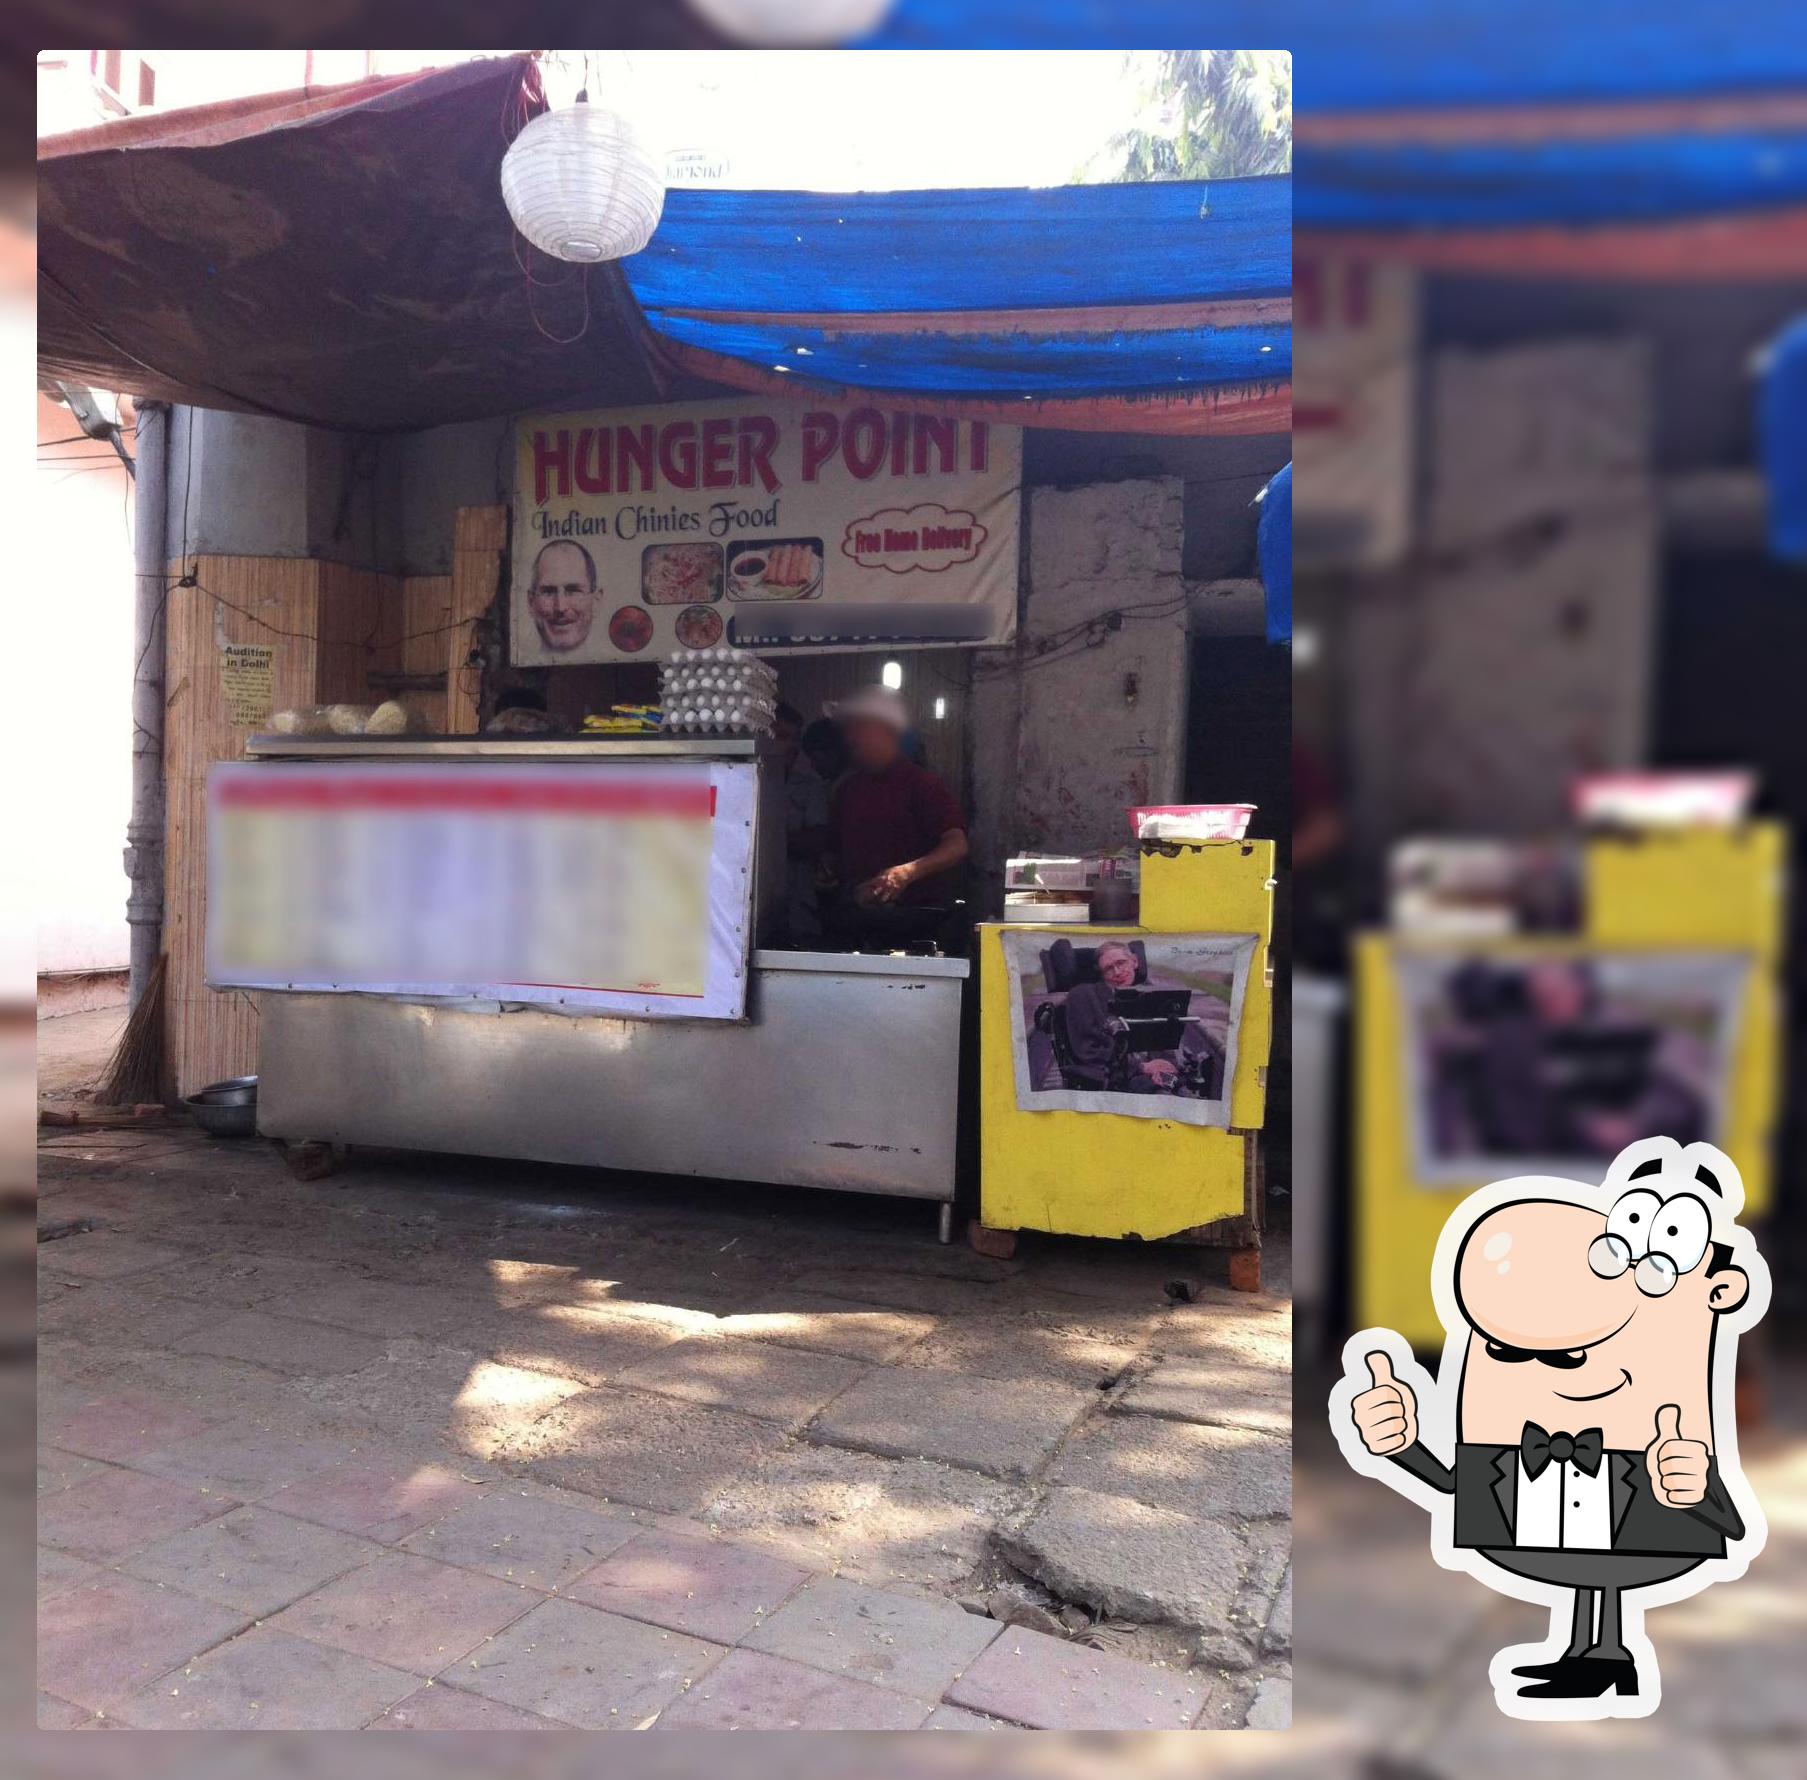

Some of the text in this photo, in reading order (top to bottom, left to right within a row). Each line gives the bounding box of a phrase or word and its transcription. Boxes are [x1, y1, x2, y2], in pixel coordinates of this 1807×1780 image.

[533, 415, 783, 507] HUNGER
[531, 499, 780, 540] Indian Chinies Food
[855, 525, 973, 553] Free Home Delivery
[225, 646, 273, 658] Audition
[240, 659, 270, 669] Delhi
